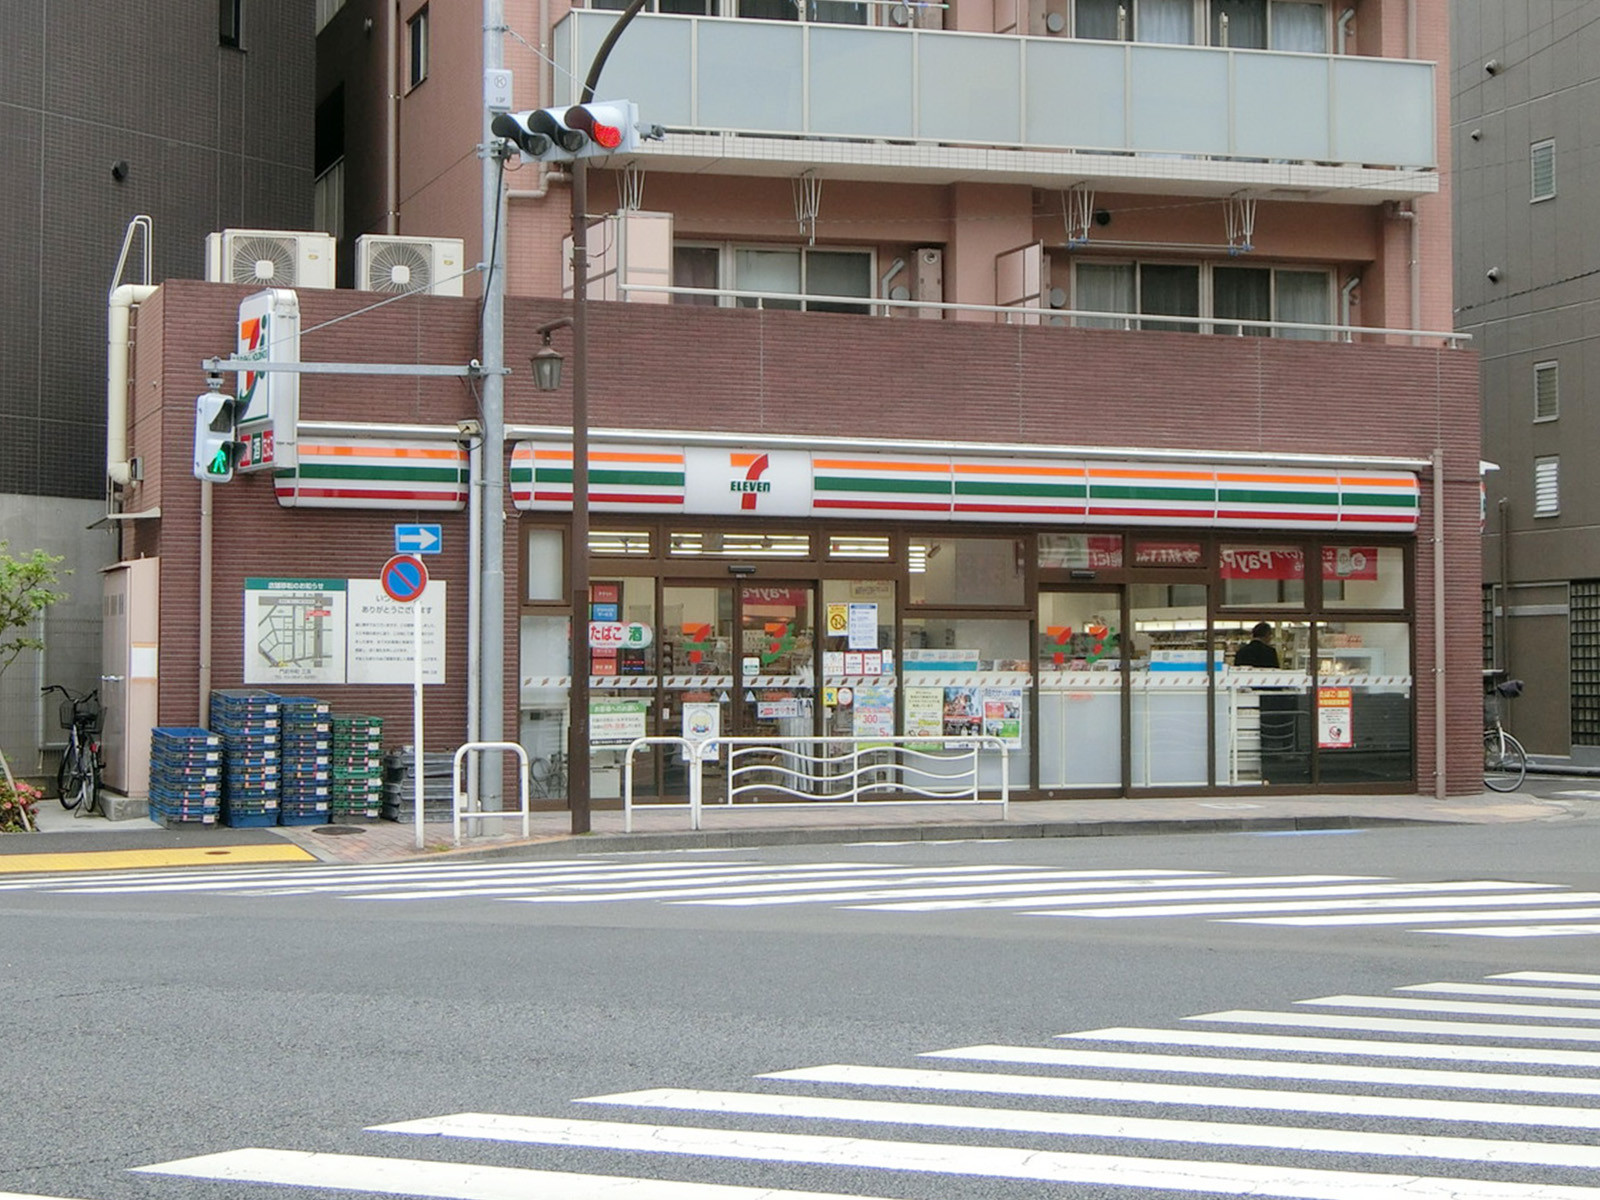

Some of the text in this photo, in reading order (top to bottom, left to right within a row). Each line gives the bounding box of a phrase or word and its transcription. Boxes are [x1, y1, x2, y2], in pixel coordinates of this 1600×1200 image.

[730, 453, 769, 510] 7
[591, 625, 643, 642] たばこ 酒
